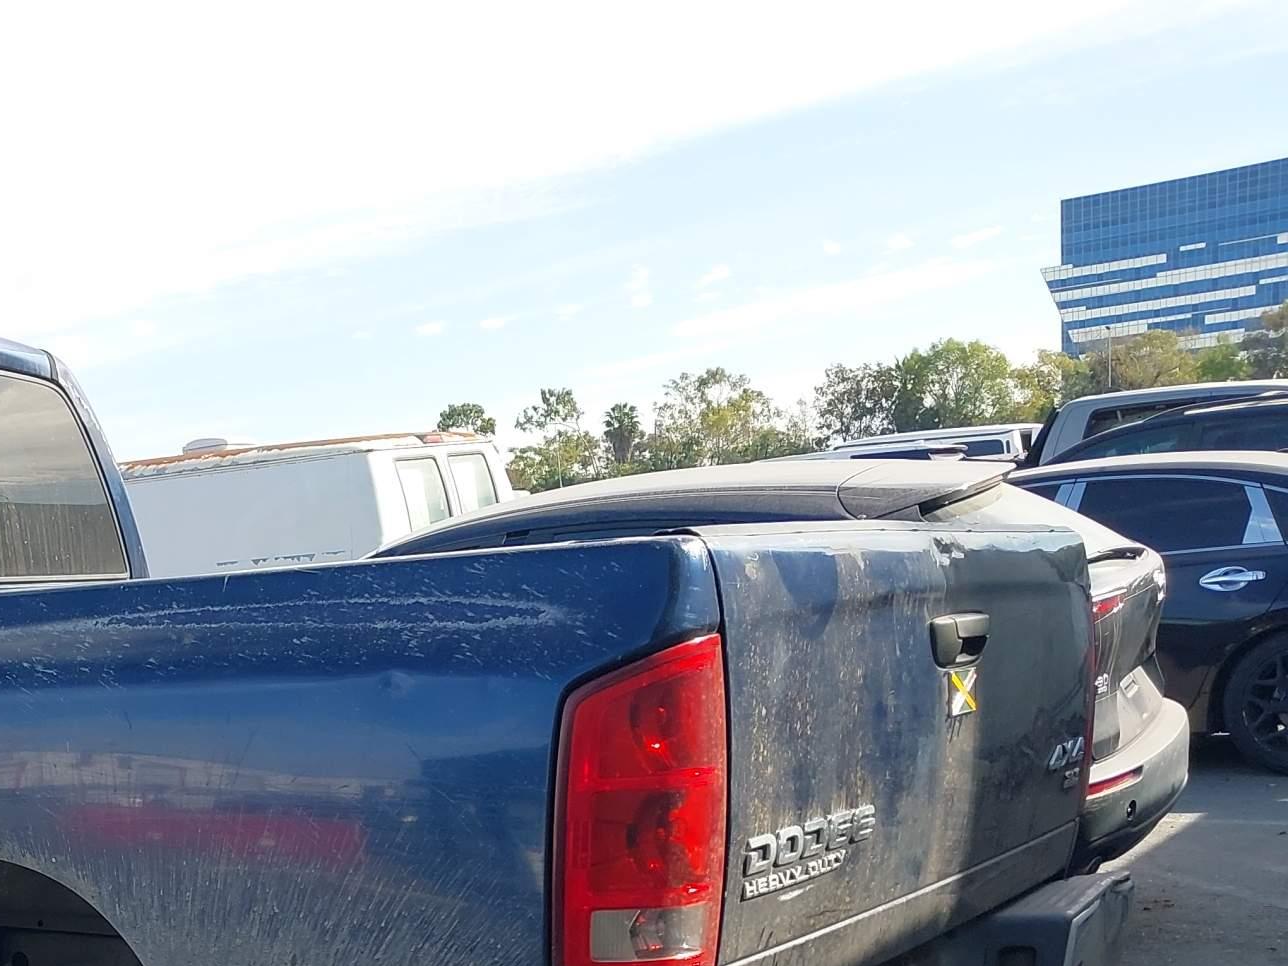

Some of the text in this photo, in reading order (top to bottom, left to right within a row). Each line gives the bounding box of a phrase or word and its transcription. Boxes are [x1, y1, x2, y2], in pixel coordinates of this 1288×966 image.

[743, 804, 876, 878] DODGE
[743, 849, 847, 899] HEAVY DUTY
